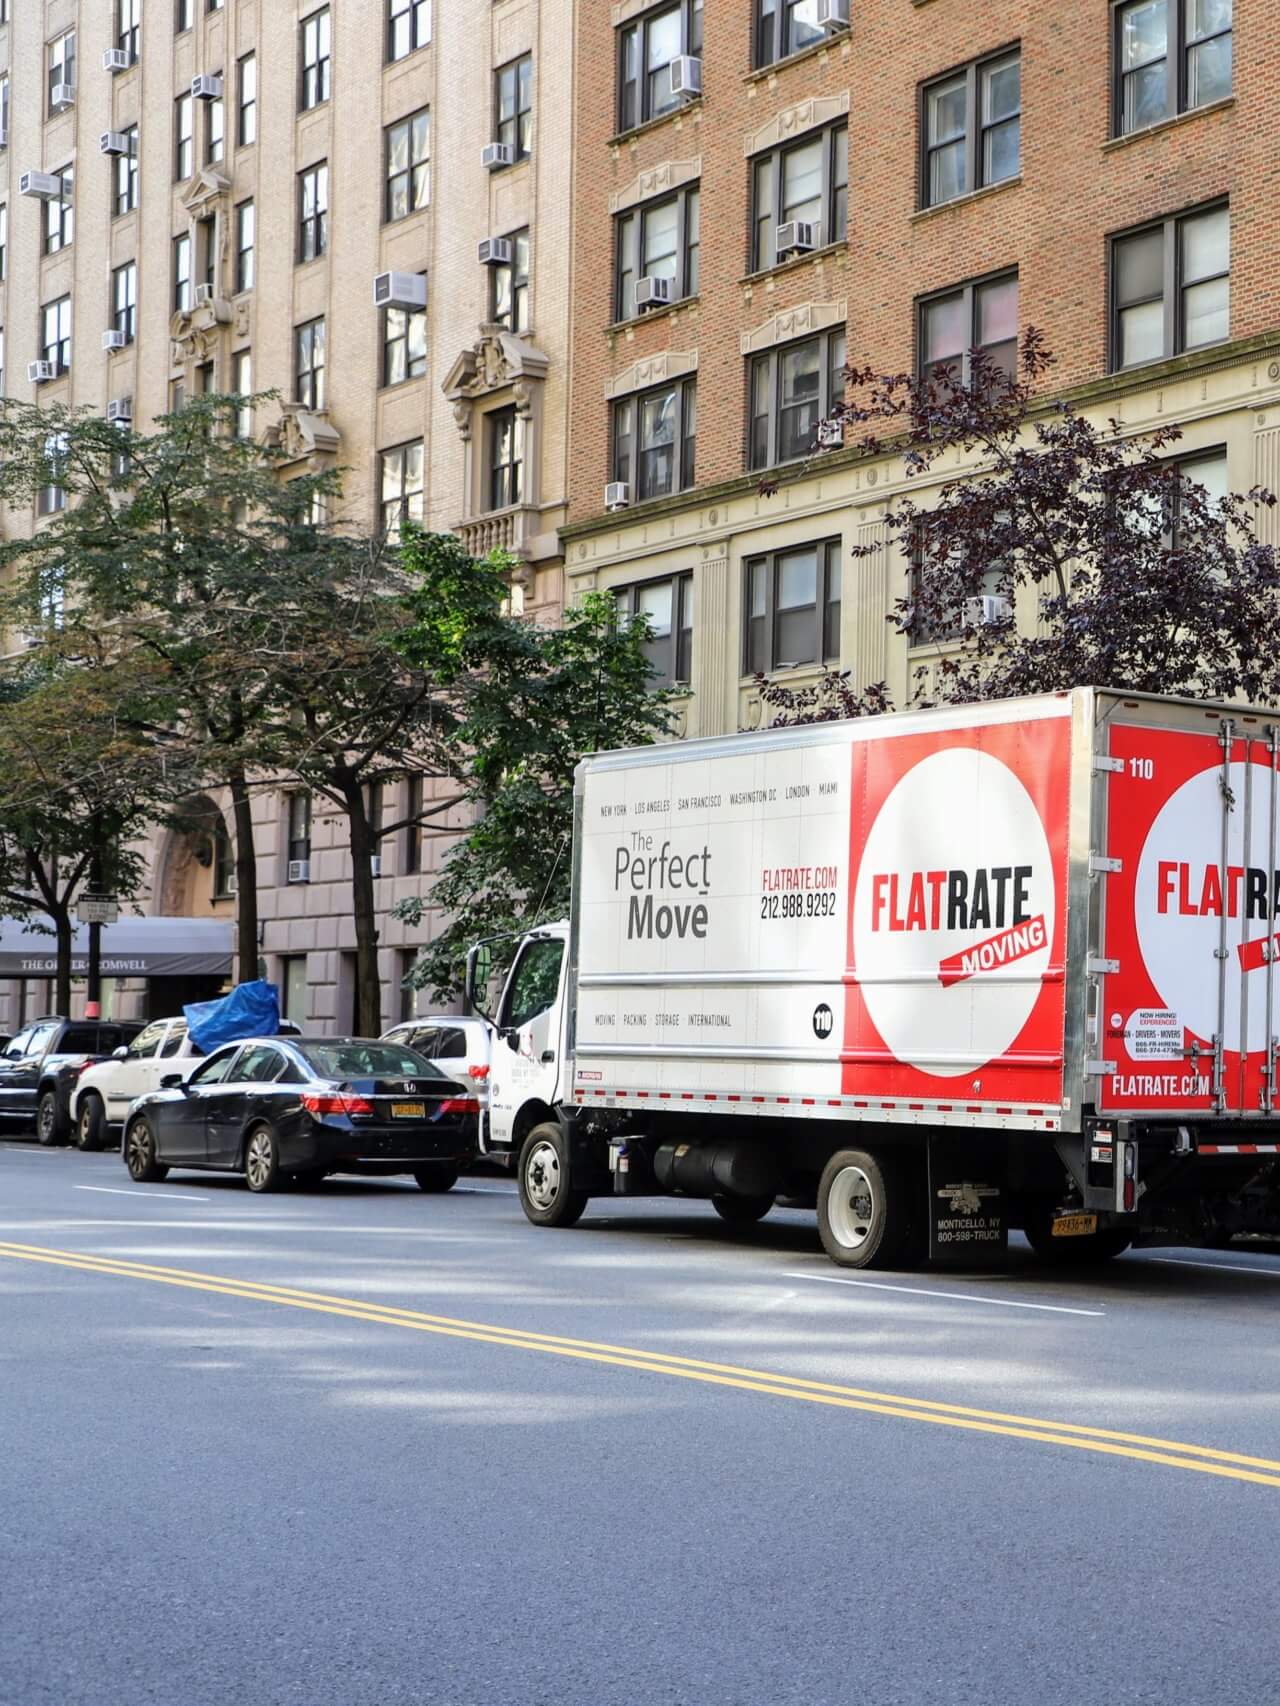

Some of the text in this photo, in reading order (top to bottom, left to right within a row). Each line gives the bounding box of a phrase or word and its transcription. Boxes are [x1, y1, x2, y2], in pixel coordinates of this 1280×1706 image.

[1128, 757, 1153, 780] 110
[729, 788, 777, 805] WASHINGTON DC
[785, 784, 810, 799] LONDON
[819, 781, 838, 796] MIAMI
[600, 804, 628, 817] NEW YORK
[634, 799, 670, 815] LOS ANGELES
[678, 794, 722, 811] SAN FRANCISCO
[631, 830, 653, 851] The
[615, 841, 712, 890] Perfect
[762, 866, 838, 891] FLATRATE.COM
[761, 892, 836, 919] 212.988.9292
[871, 865, 1033, 932] FLATRATE
[628, 894, 708, 939] Move
[960, 920, 1044, 976] MOVING
[22, 959, 43, 970] THE
[595, 1014, 732, 1027] MOVING PACKING STORAGE INTERNATIONAL
[814, 1010, 832, 1032] 110
[1135, 1030, 1157, 1039] DRIVERS
[1160, 1030, 1181, 1039] MOVERS
[937, 1217, 1000, 1229] MONTICELLO, NY
[937, 1230, 1000, 1242] 800-598-TRUCK
